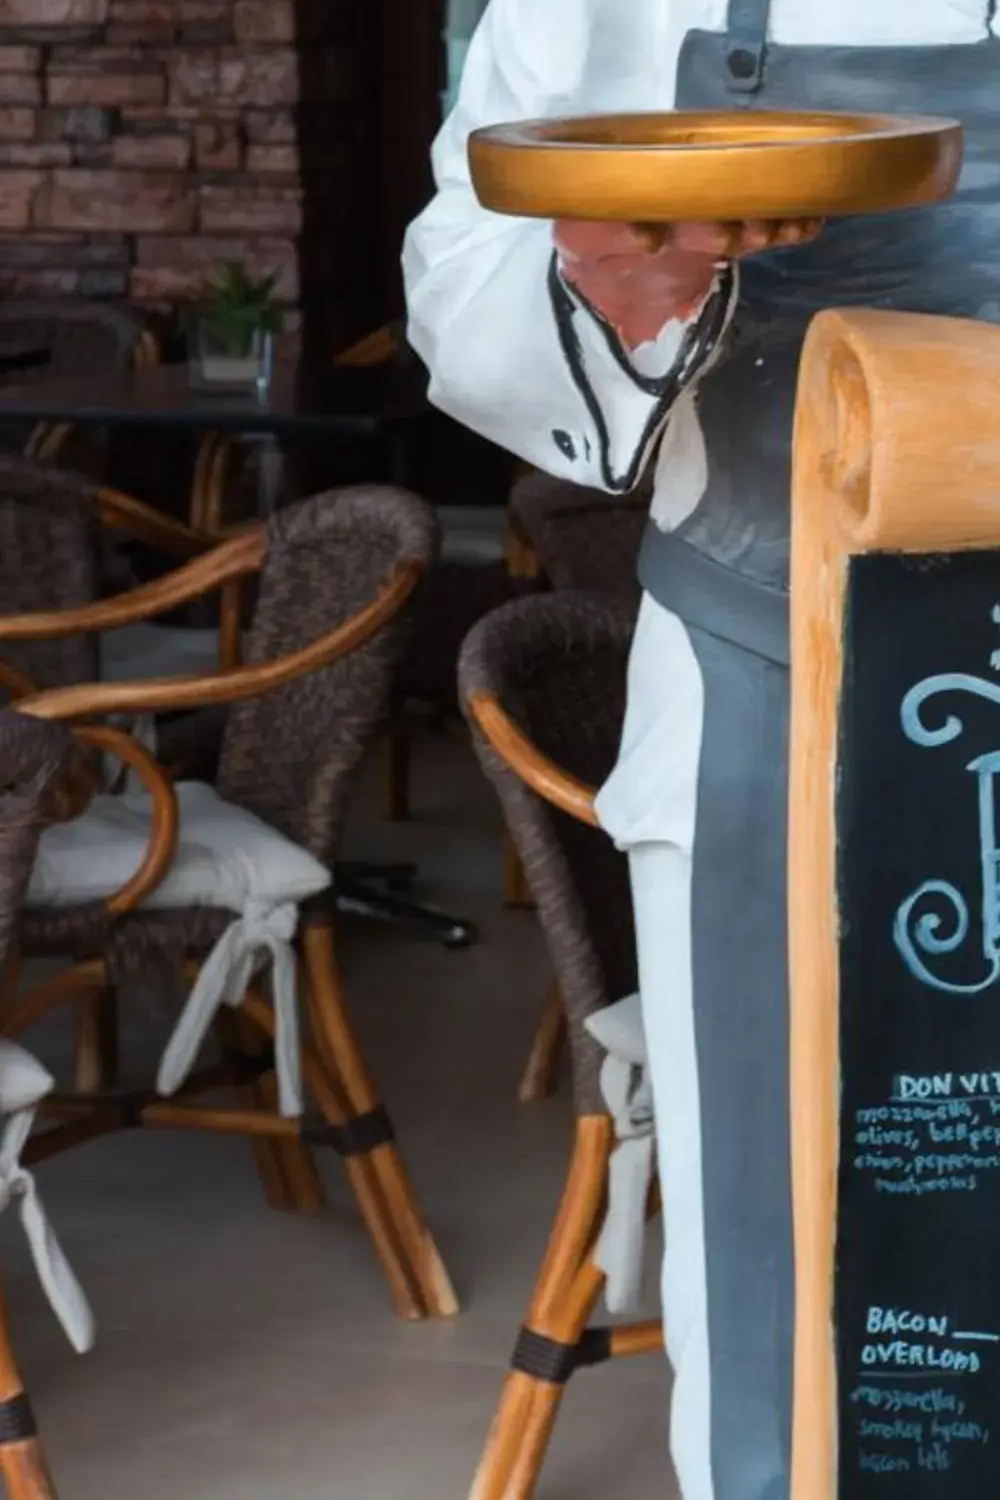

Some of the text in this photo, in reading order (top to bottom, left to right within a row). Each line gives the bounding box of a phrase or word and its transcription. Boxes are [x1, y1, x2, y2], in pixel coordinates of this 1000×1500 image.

[899, 1072, 953, 1099] DON
[867, 1306, 947, 1336] BACON
[861, 1341, 980, 1372] OVERLOAD
